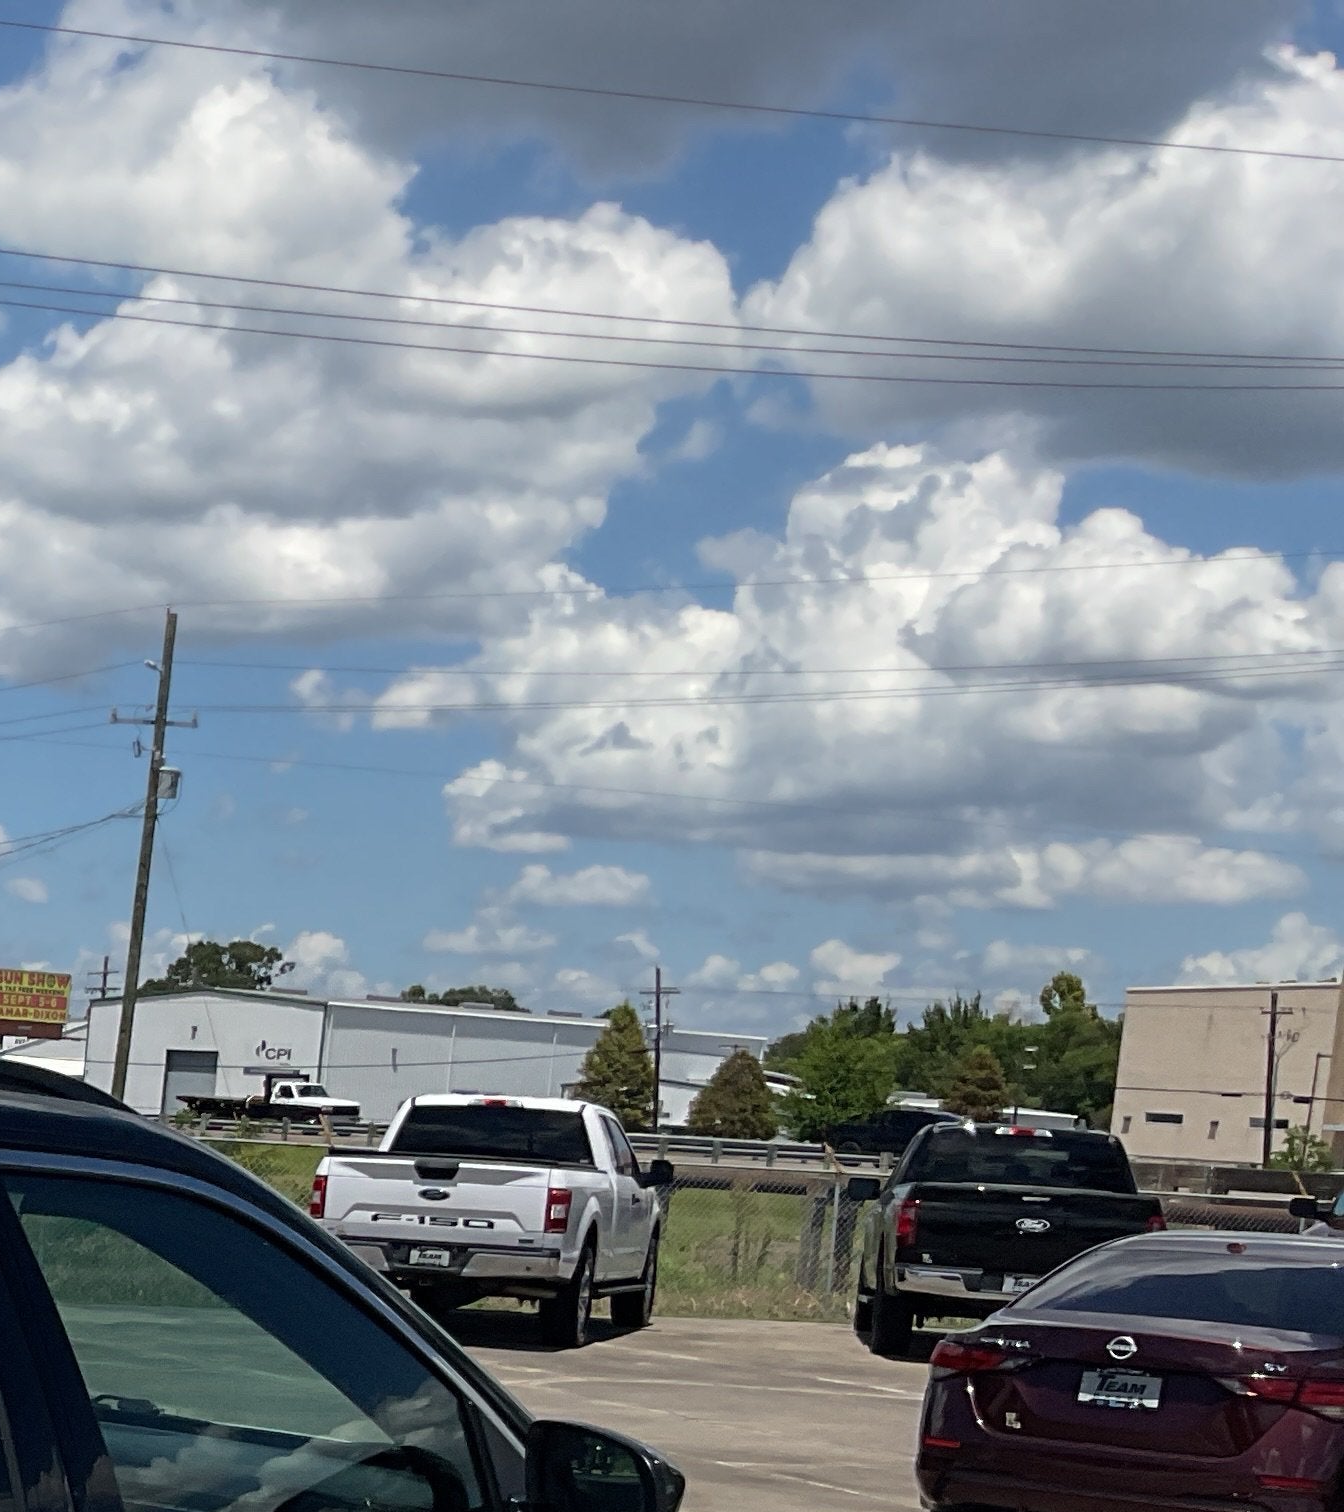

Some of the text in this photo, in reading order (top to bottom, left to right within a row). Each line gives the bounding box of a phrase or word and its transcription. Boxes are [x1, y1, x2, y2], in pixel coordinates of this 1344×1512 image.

[28, 973, 70, 988] SHOW
[3, 994, 32, 1006] SEPT
[265, 1047, 292, 1060] CPI
[371, 1212, 494, 1229] F-150
[1096, 1373, 1148, 1395] TEAM
